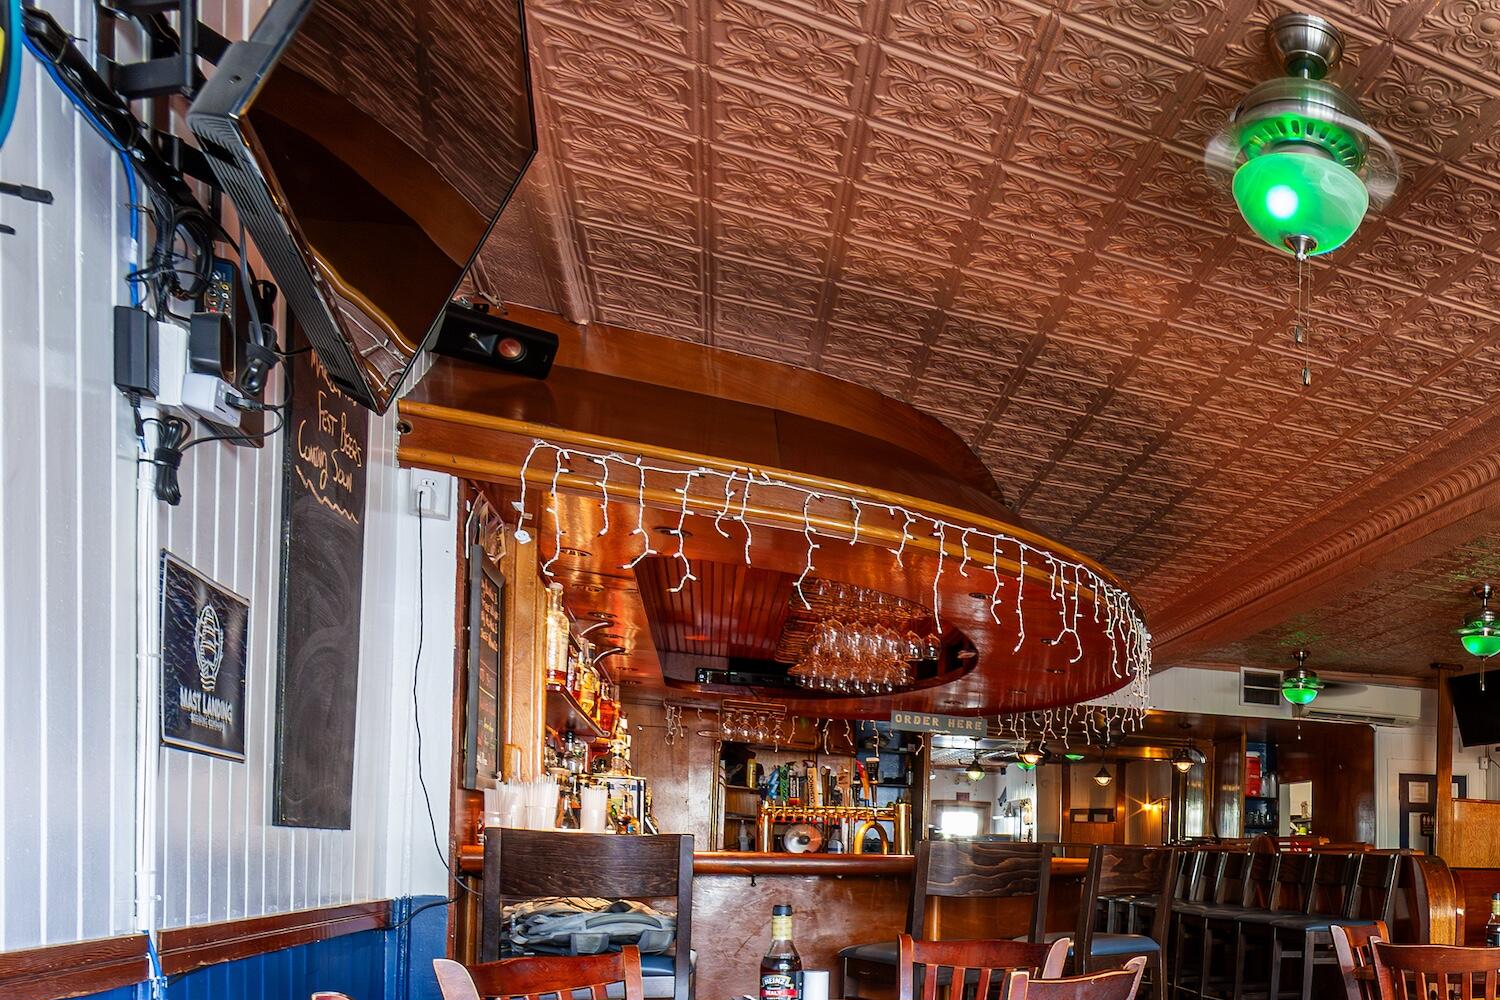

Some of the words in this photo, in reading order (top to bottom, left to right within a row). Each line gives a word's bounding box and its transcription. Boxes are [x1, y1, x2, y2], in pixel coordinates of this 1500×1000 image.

[180, 686, 201, 712] MAST
[202, 692, 233, 725] LANDING
[895, 713, 940, 727] ORDER
[947, 718, 982, 731] HERE
